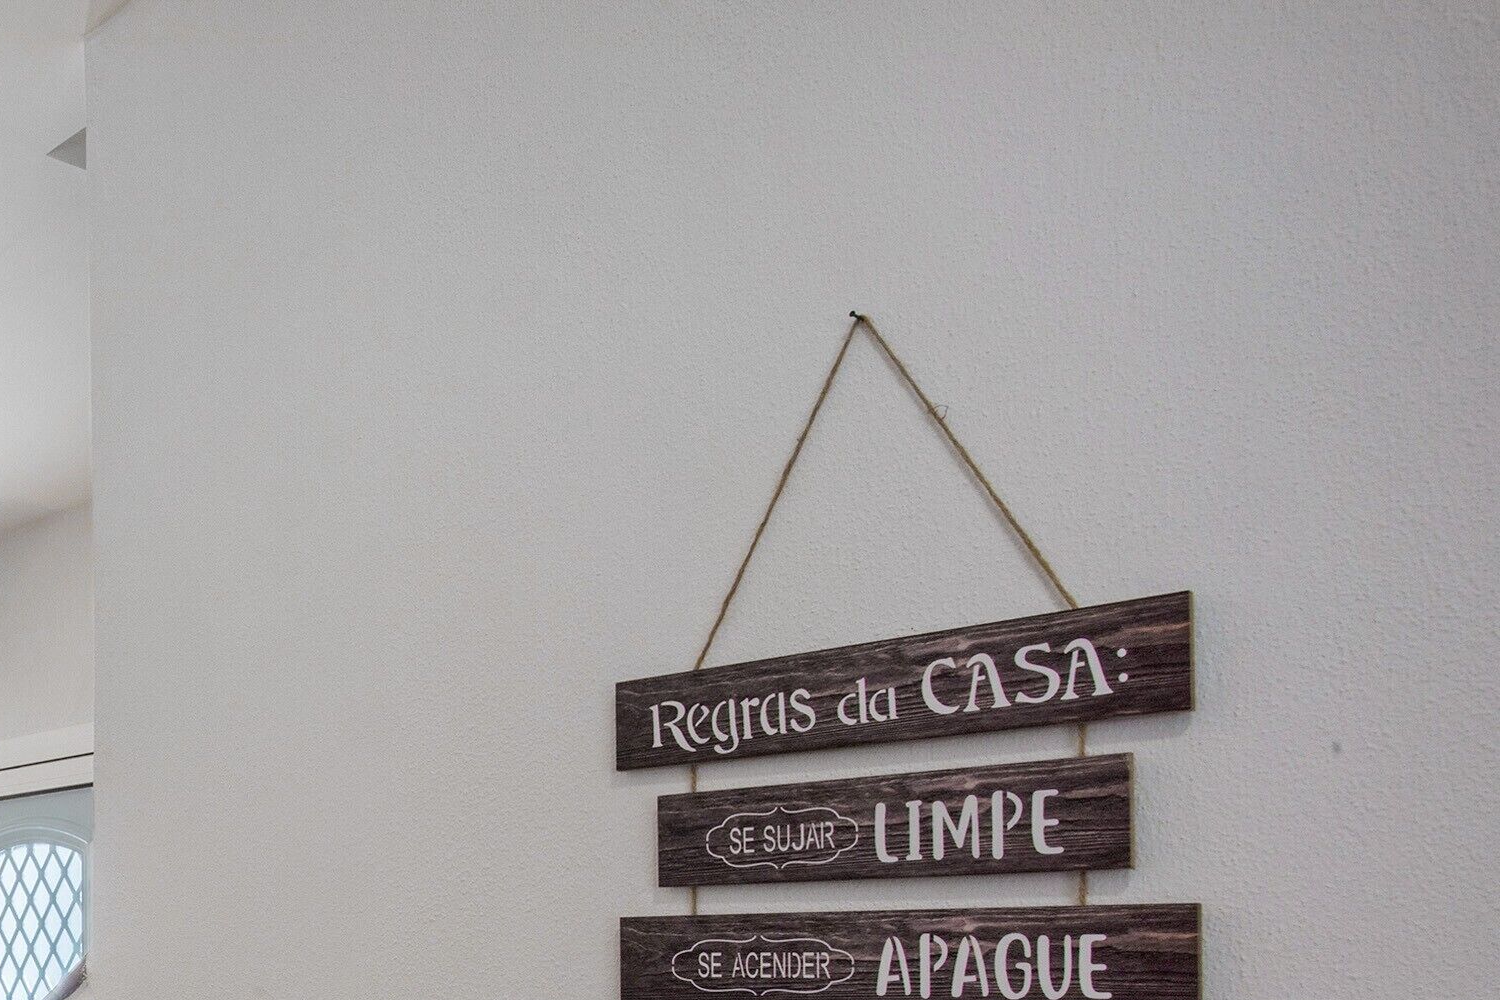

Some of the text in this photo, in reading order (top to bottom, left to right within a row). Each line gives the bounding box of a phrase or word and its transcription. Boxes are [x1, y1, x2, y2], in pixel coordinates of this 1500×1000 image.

[649, 635, 1130, 756] Regras da CASA:
[727, 788, 1066, 863] SE SUJAR LIMPE
[697, 932, 1113, 1000] SE ACENDER APAGUE
